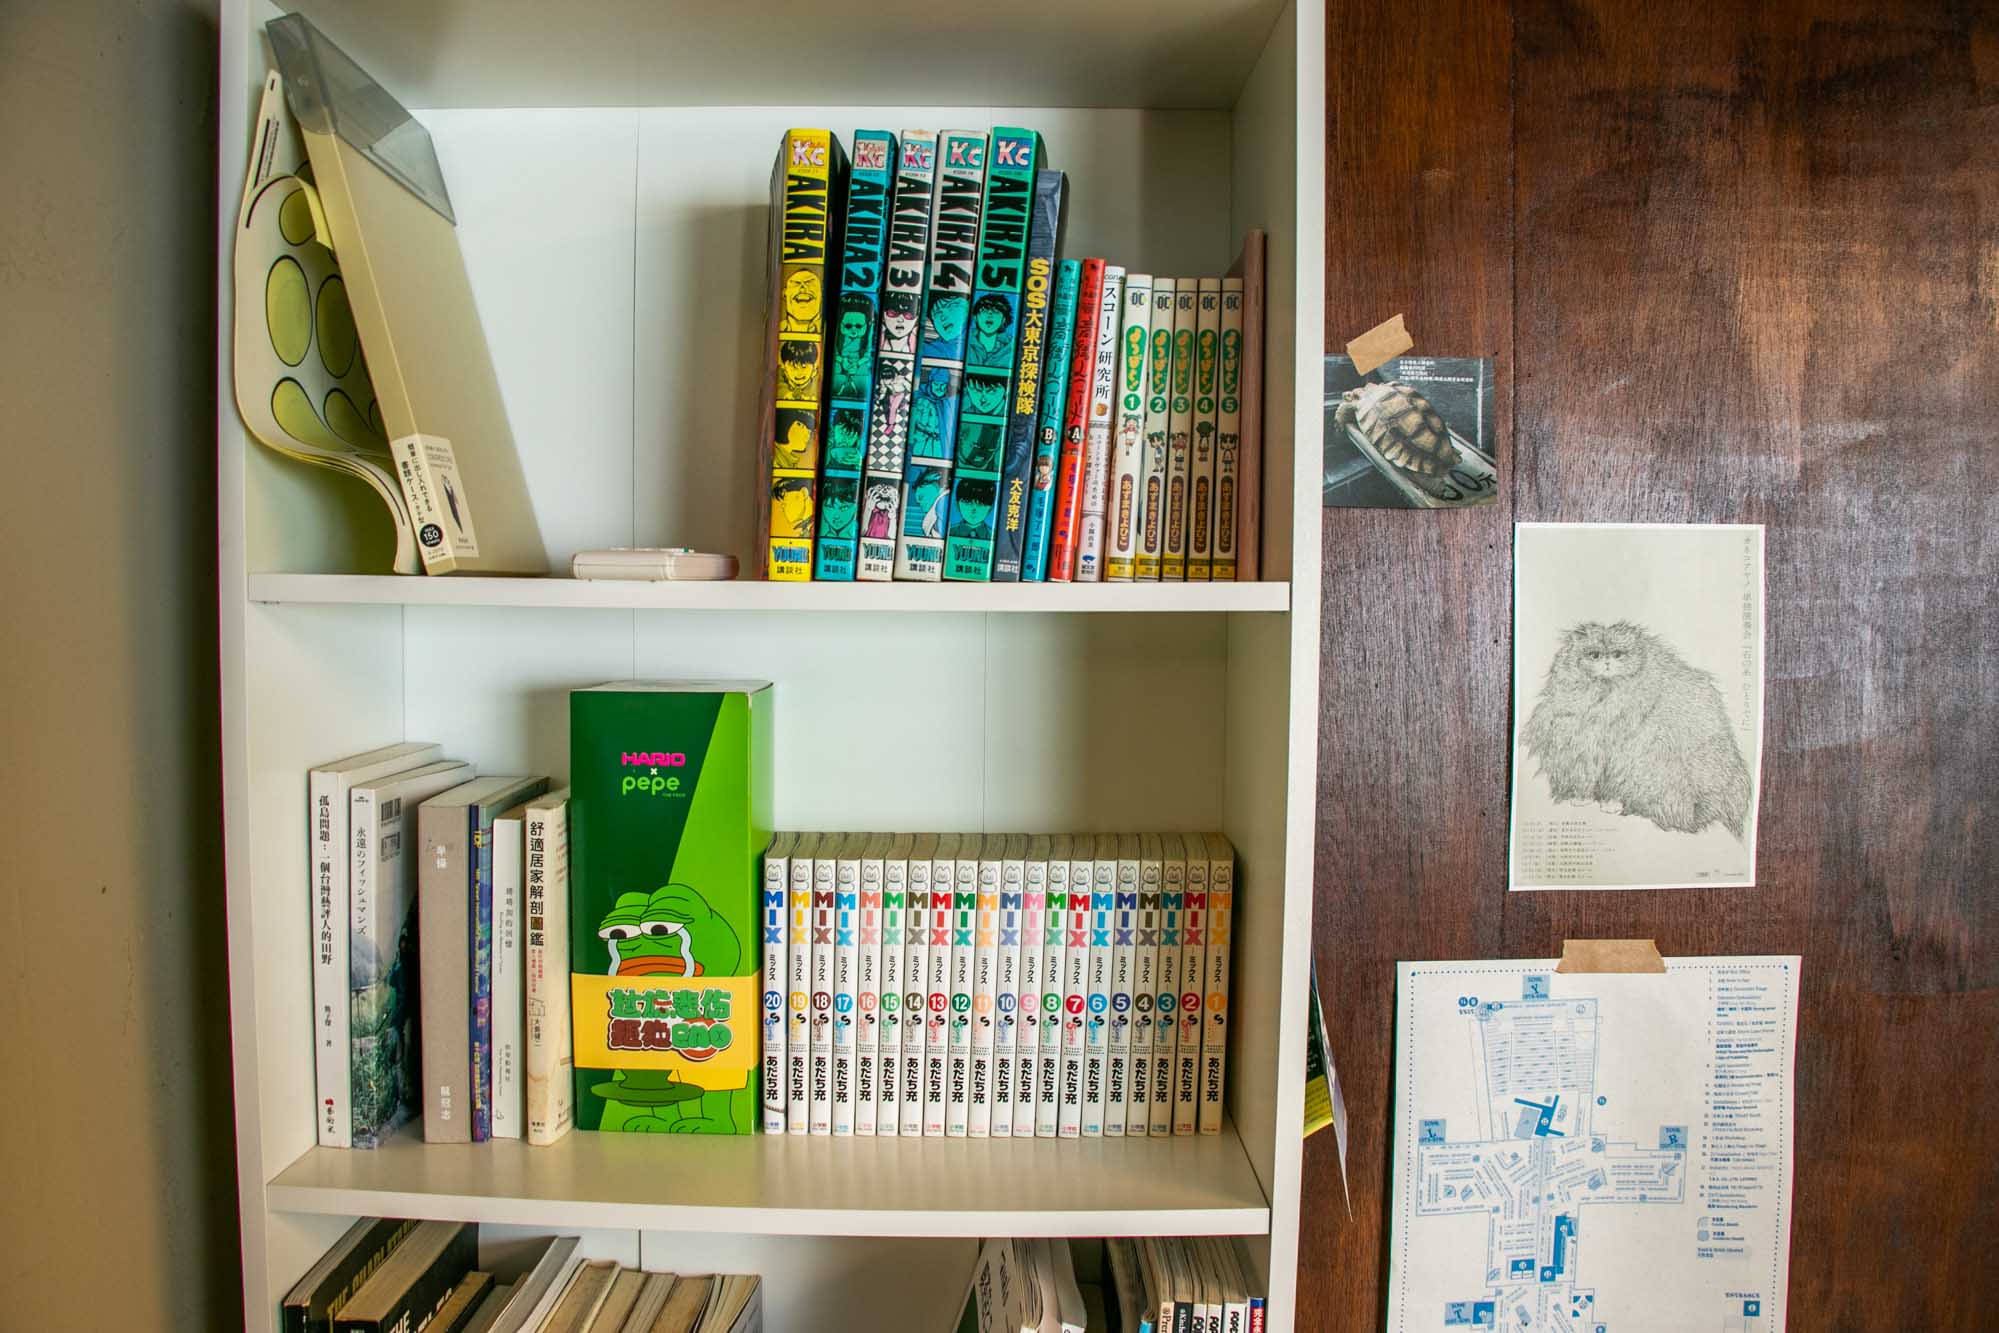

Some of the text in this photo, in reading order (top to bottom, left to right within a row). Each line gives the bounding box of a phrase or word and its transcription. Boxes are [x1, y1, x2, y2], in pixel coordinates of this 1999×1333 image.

[783, 174, 827, 263] AKIRA
[844, 178, 886, 269] AKIRA
[889, 176, 931, 261] AKIRA
[934, 174, 982, 261] AKIRA
[978, 175, 1030, 262] AKIRA
[1016, 258, 1049, 415] SOS大東京探検隊
[1095, 287, 1116, 399] スコーン研究所
[1072, 427, 1080, 439] A
[1007, 478, 1023, 532] 大友克洋
[424, 530, 439, 541] 150
[622, 752, 685, 767] HARIO
[622, 776, 680, 795] pepe
[530, 821, 544, 947] 舒適居家解剖圖鑑
[764, 891, 783, 944] MIX
[791, 892, 810, 944] MIX
[814, 892, 833, 944] MIX
[836, 893, 856, 945] MIX
[861, 892, 880, 944] MIX
[884, 892, 904, 944] MIX
[908, 892, 928, 944] MIX
[931, 893, 952, 945] MIX
[954, 893, 975, 945] MIX
[977, 894, 997, 947] MIX
[1000, 893, 1021, 946] MIX
[1023, 893, 1044, 946] MIX
[1046, 893, 1066, 945] MIX
[1069, 894, 1090, 947] MIX
[1092, 893, 1113, 947] MIX
[1115, 893, 1136, 945] MIX
[1138, 893, 1160, 946] MIX
[1161, 893, 1182, 946] MIX
[1184, 893, 1205, 945] MIX
[1210, 893, 1231, 944] MIX
[766, 1056, 778, 1100] あだち充
[792, 1056, 803, 1100] あだち充
[815, 1057, 826, 1100] あだち充
[836, 1059, 847, 1102] あだち充
[860, 1057, 871, 1101] あだち充
[883, 1058, 894, 1101] あだち充
[906, 1058, 918, 1101] あだち充
[929, 1058, 941, 1102] あだち充
[952, 1058, 964, 1102] あだち充
[974, 1059, 985, 1103] あだち充
[998, 1058, 1010, 1102] あだち充
[1020, 1058, 1032, 1102] あだち充
[1042, 1058, 1055, 1102] あだち充
[1065, 1060, 1078, 1104] あだち充
[1088, 1058, 1100, 1102] あだち充
[1110, 1058, 1123, 1102] あだち充
[1134, 1058, 1146, 1102] あだち充
[1156, 1058, 1168, 1102] あだち充
[1180, 1058, 1193, 1101] あだち充
[1207, 1058, 1219, 1101] あだち充
